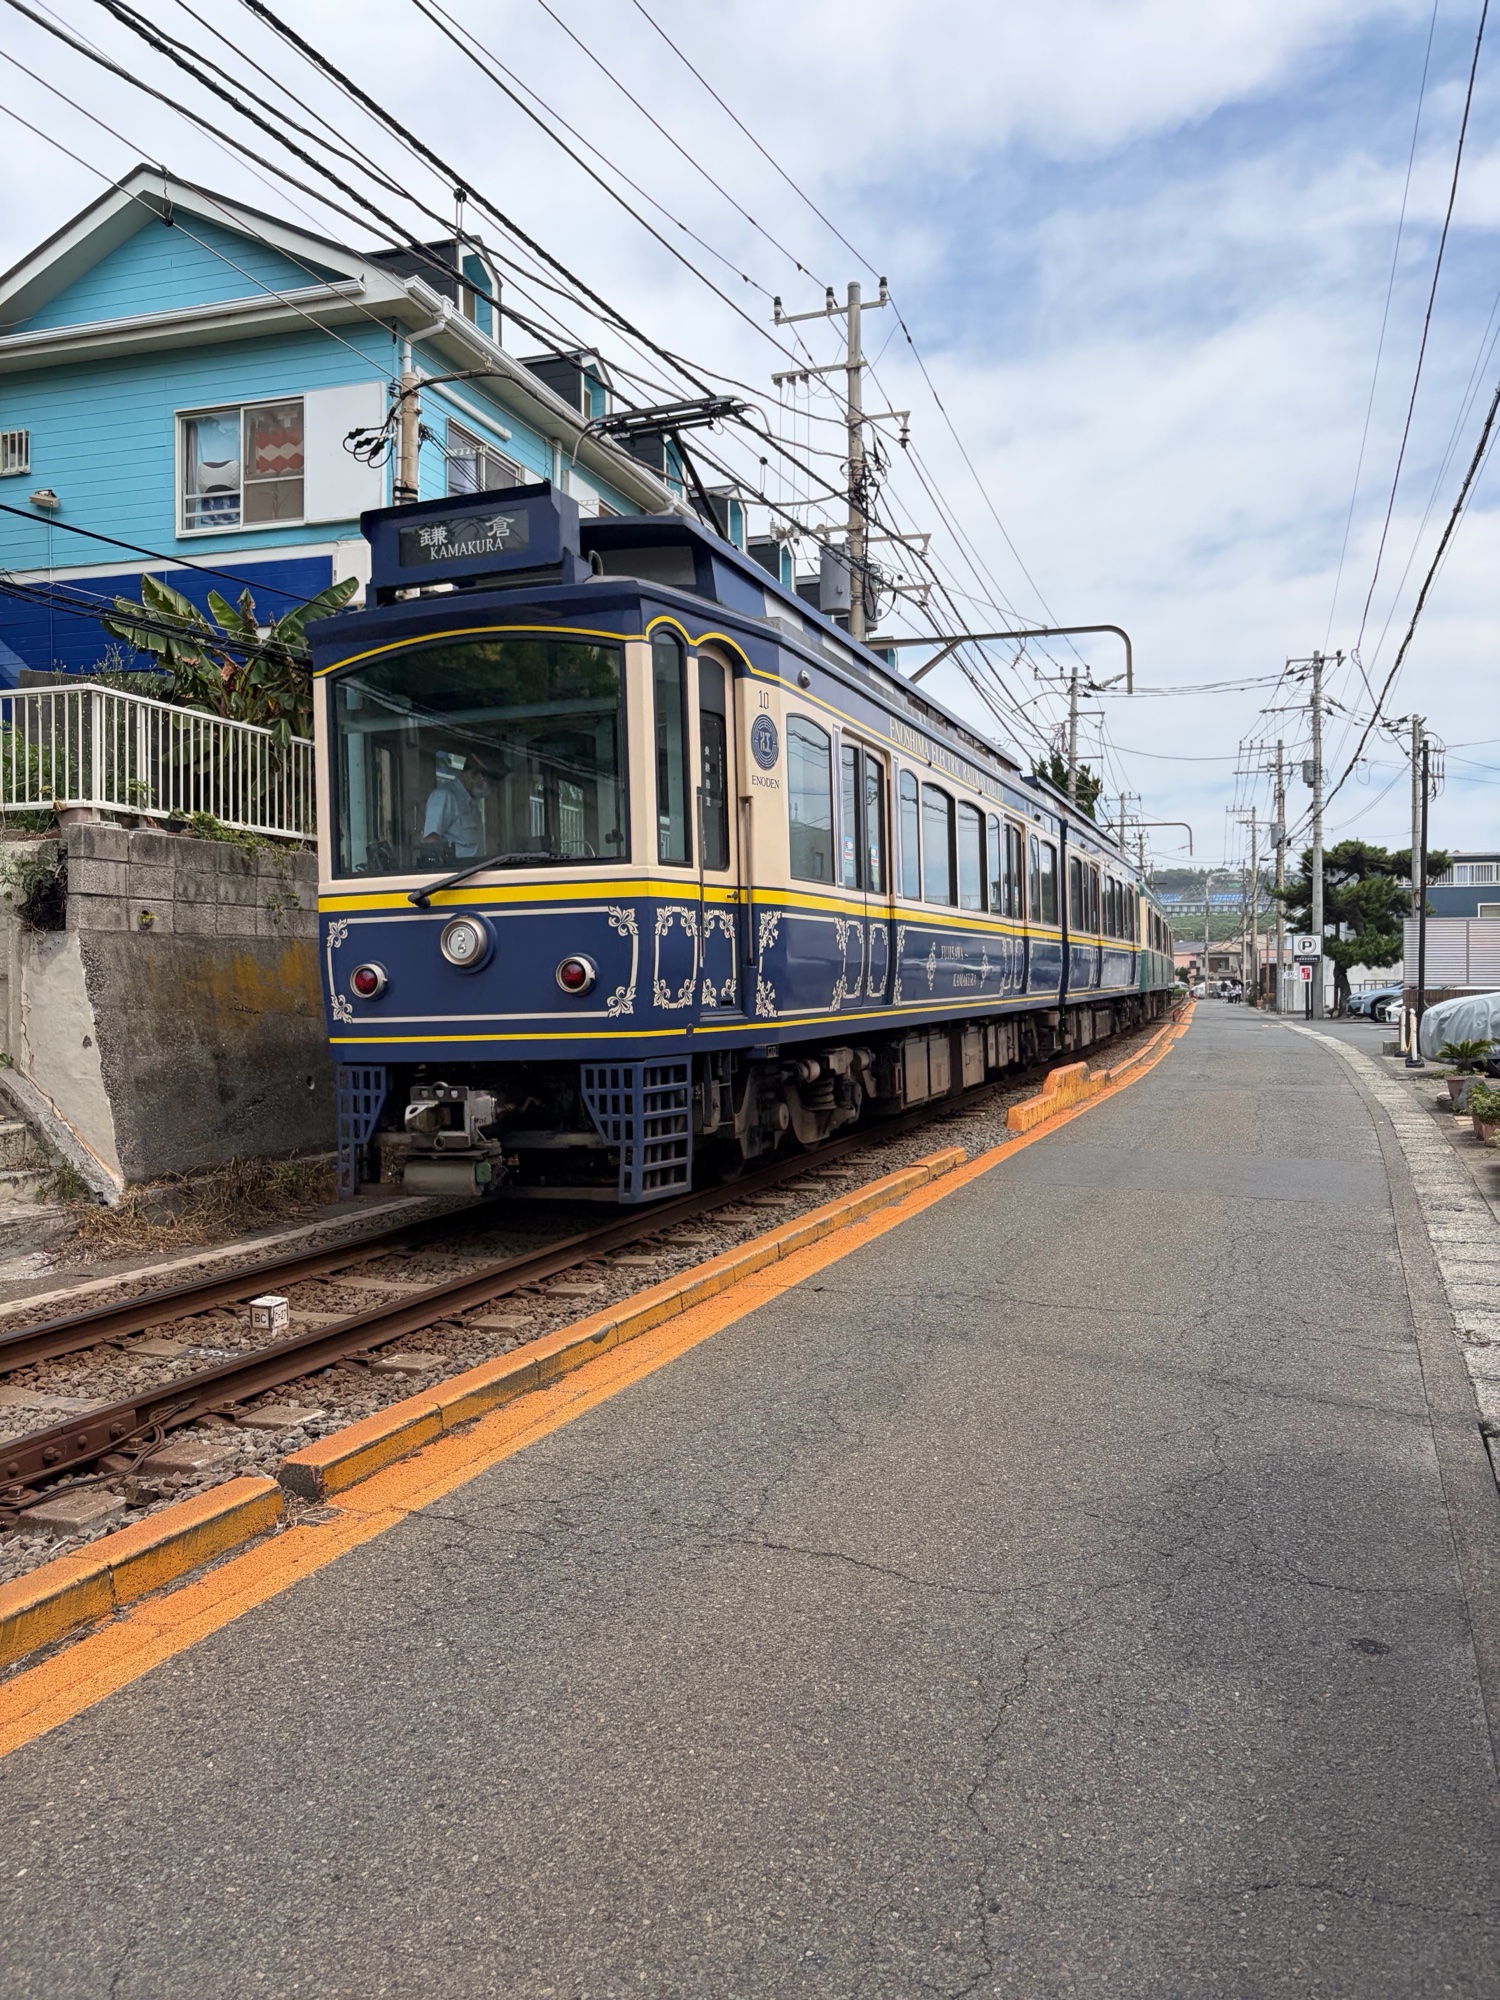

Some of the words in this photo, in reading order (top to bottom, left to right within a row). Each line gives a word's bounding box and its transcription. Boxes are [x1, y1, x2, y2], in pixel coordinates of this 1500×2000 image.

[419, 516, 515, 547] 鎌倉
[430, 538, 503, 560] KAMAKURA
[759, 690, 769, 709] 10
[889, 716, 929, 760] ENOSHIMA
[752, 775, 779, 789] ENODEN
[1303, 941, 1312, 950] P
[254, 1313, 267, 1324] BC
